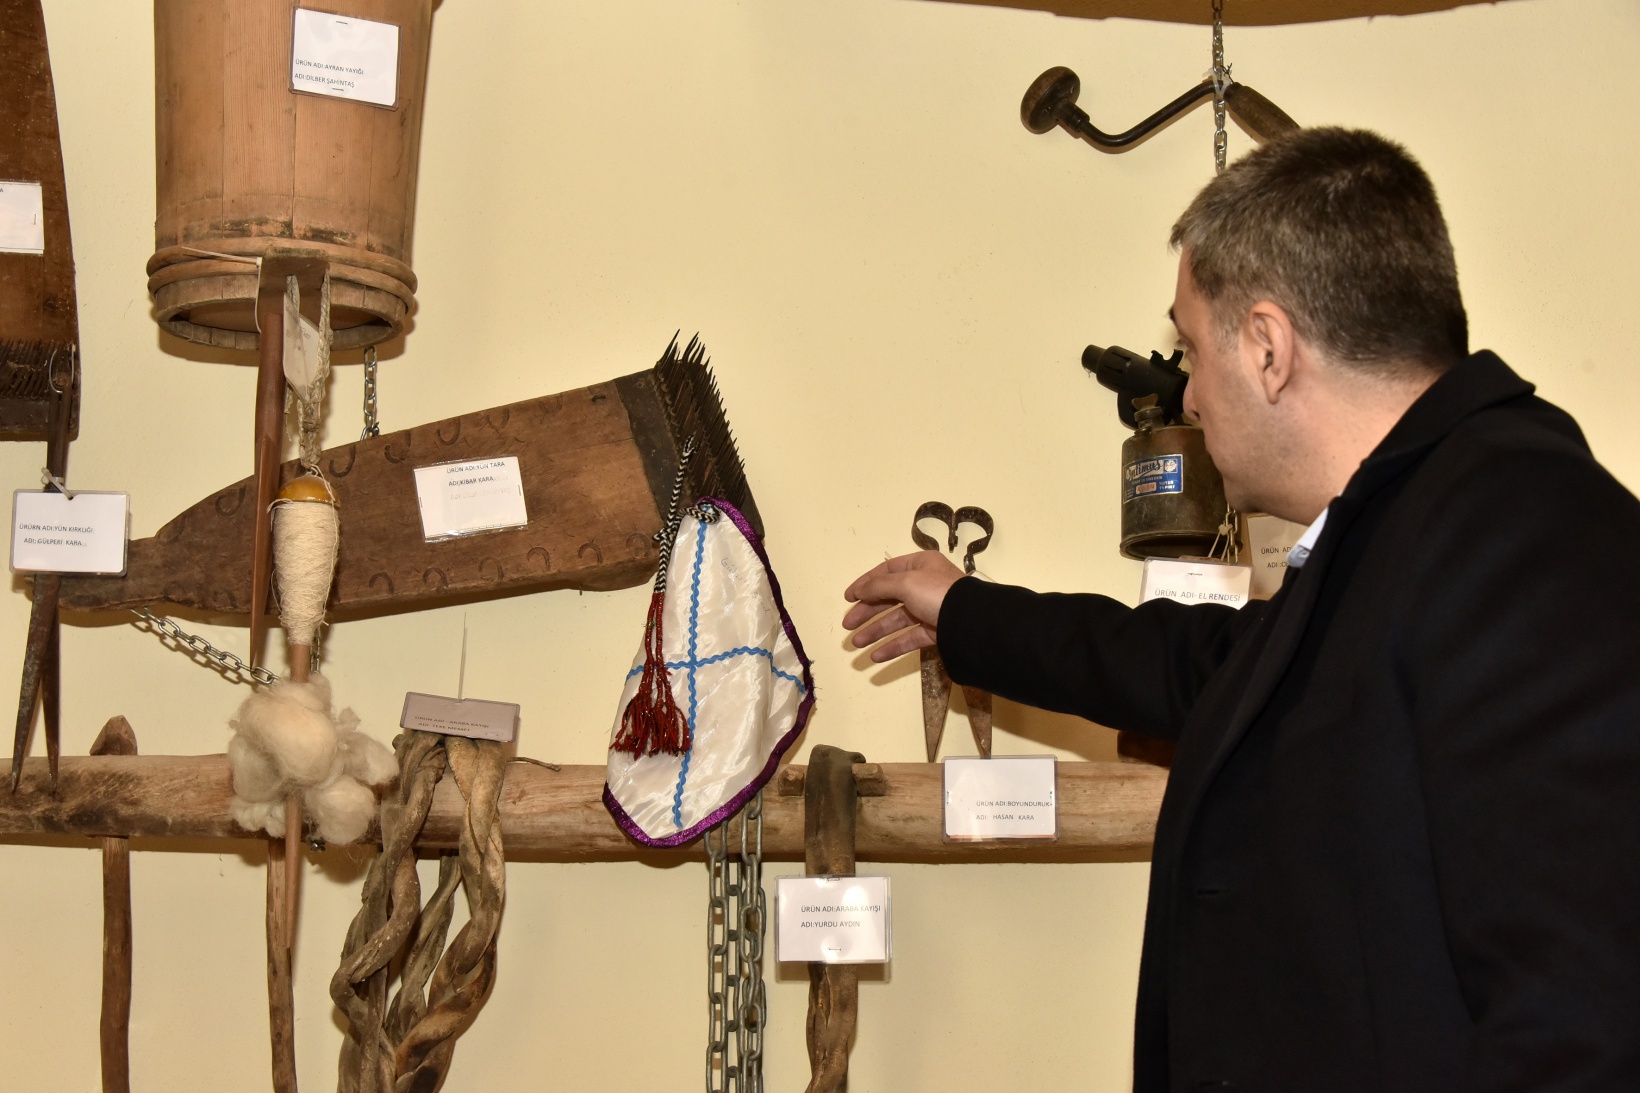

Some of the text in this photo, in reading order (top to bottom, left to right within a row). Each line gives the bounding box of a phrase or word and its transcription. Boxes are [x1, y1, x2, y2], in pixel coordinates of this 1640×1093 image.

[295, 59, 312, 67] ÜRÜN
[446, 466, 464, 474] ÜRÜN
[478, 476, 494, 484] KARA
[1260, 547, 1280, 555] ÜRÜN
[1154, 588, 1177, 597] ÜRÜN
[1198, 592, 1207, 600] EL
[1208, 592, 1241, 602] RENDESİ
[800, 905, 821, 913] ÜRÜN
[860, 905, 881, 913] KAYIŞI
[839, 920, 860, 928] AYDIN
